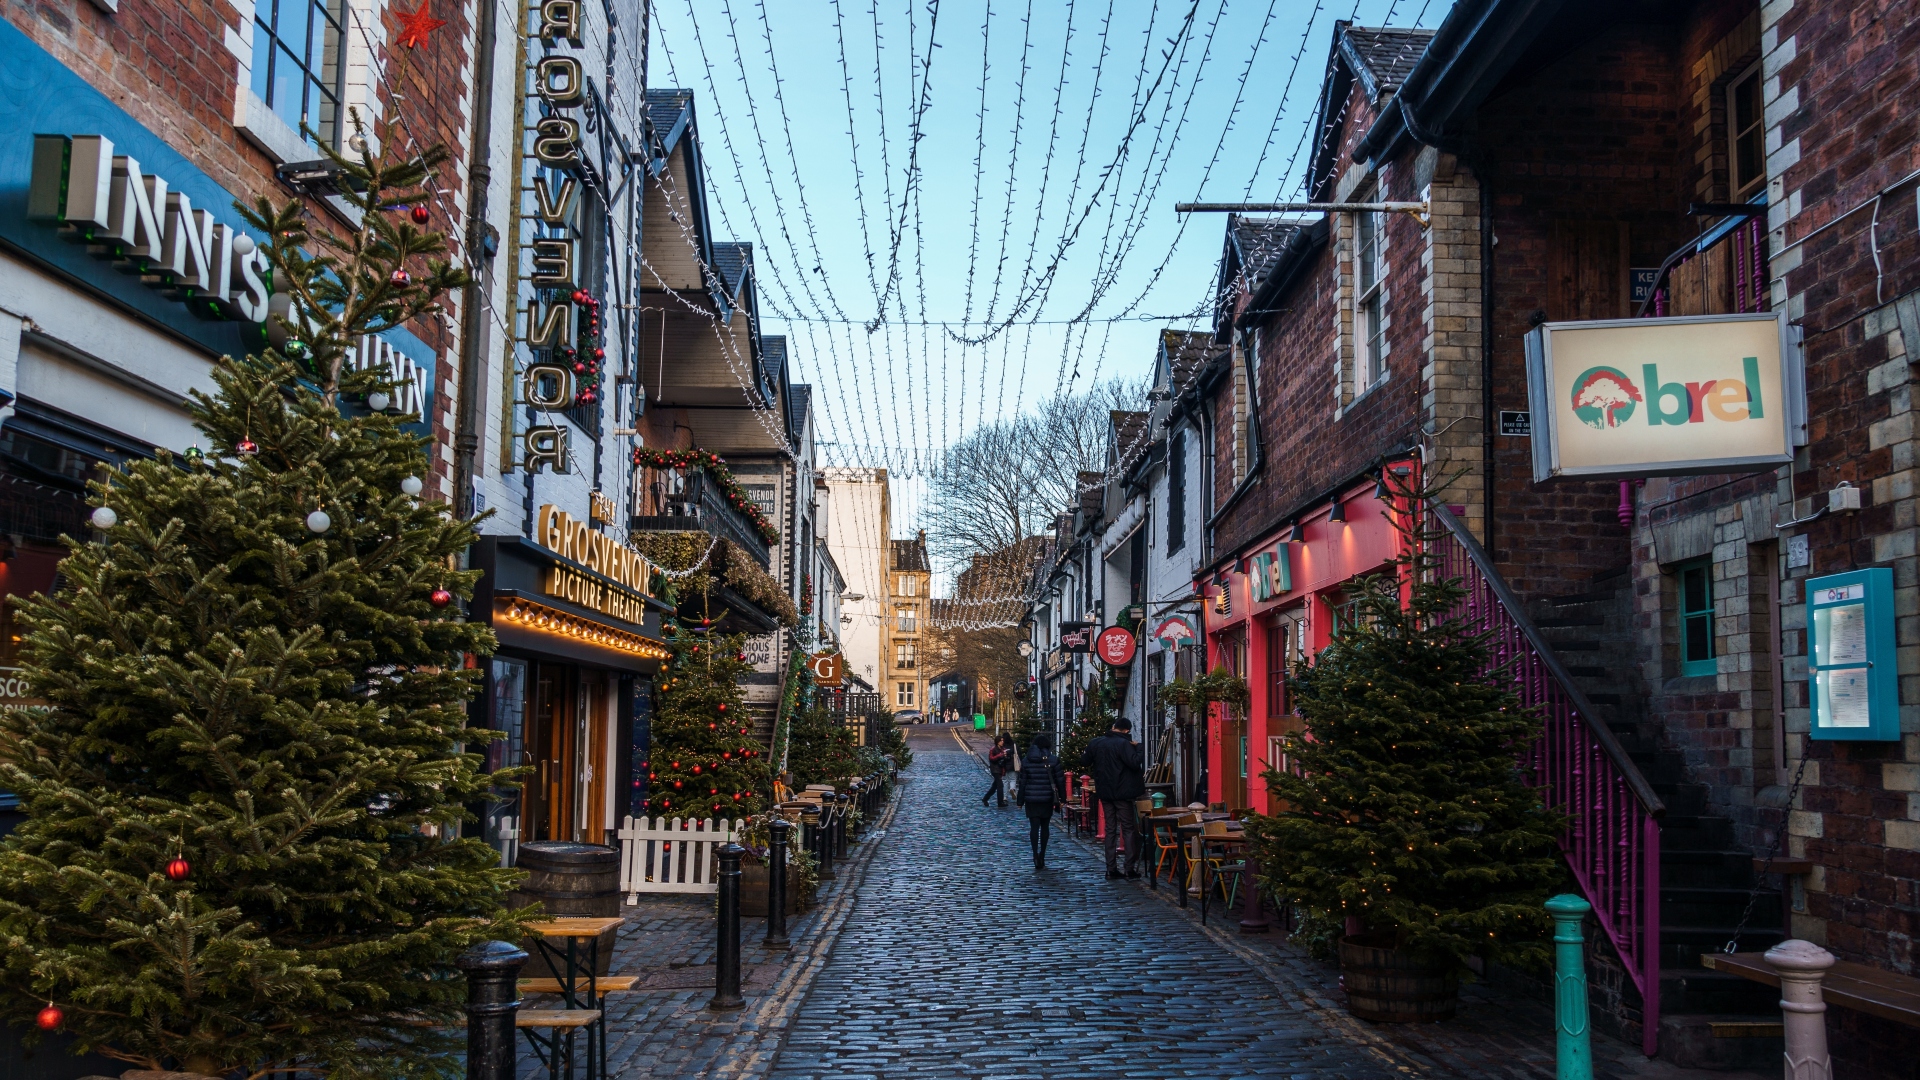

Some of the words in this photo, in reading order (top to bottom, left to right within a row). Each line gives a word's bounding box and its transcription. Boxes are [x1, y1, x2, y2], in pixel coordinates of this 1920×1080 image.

[66, 135, 271, 323] INNIS
[1642, 357, 1764, 426] brel
[539, 504, 651, 598] GROSVENOR
[550, 567, 603, 611] PICTURE
[605, 588, 645, 626] THEATRE
[815, 657, 835, 678] G
